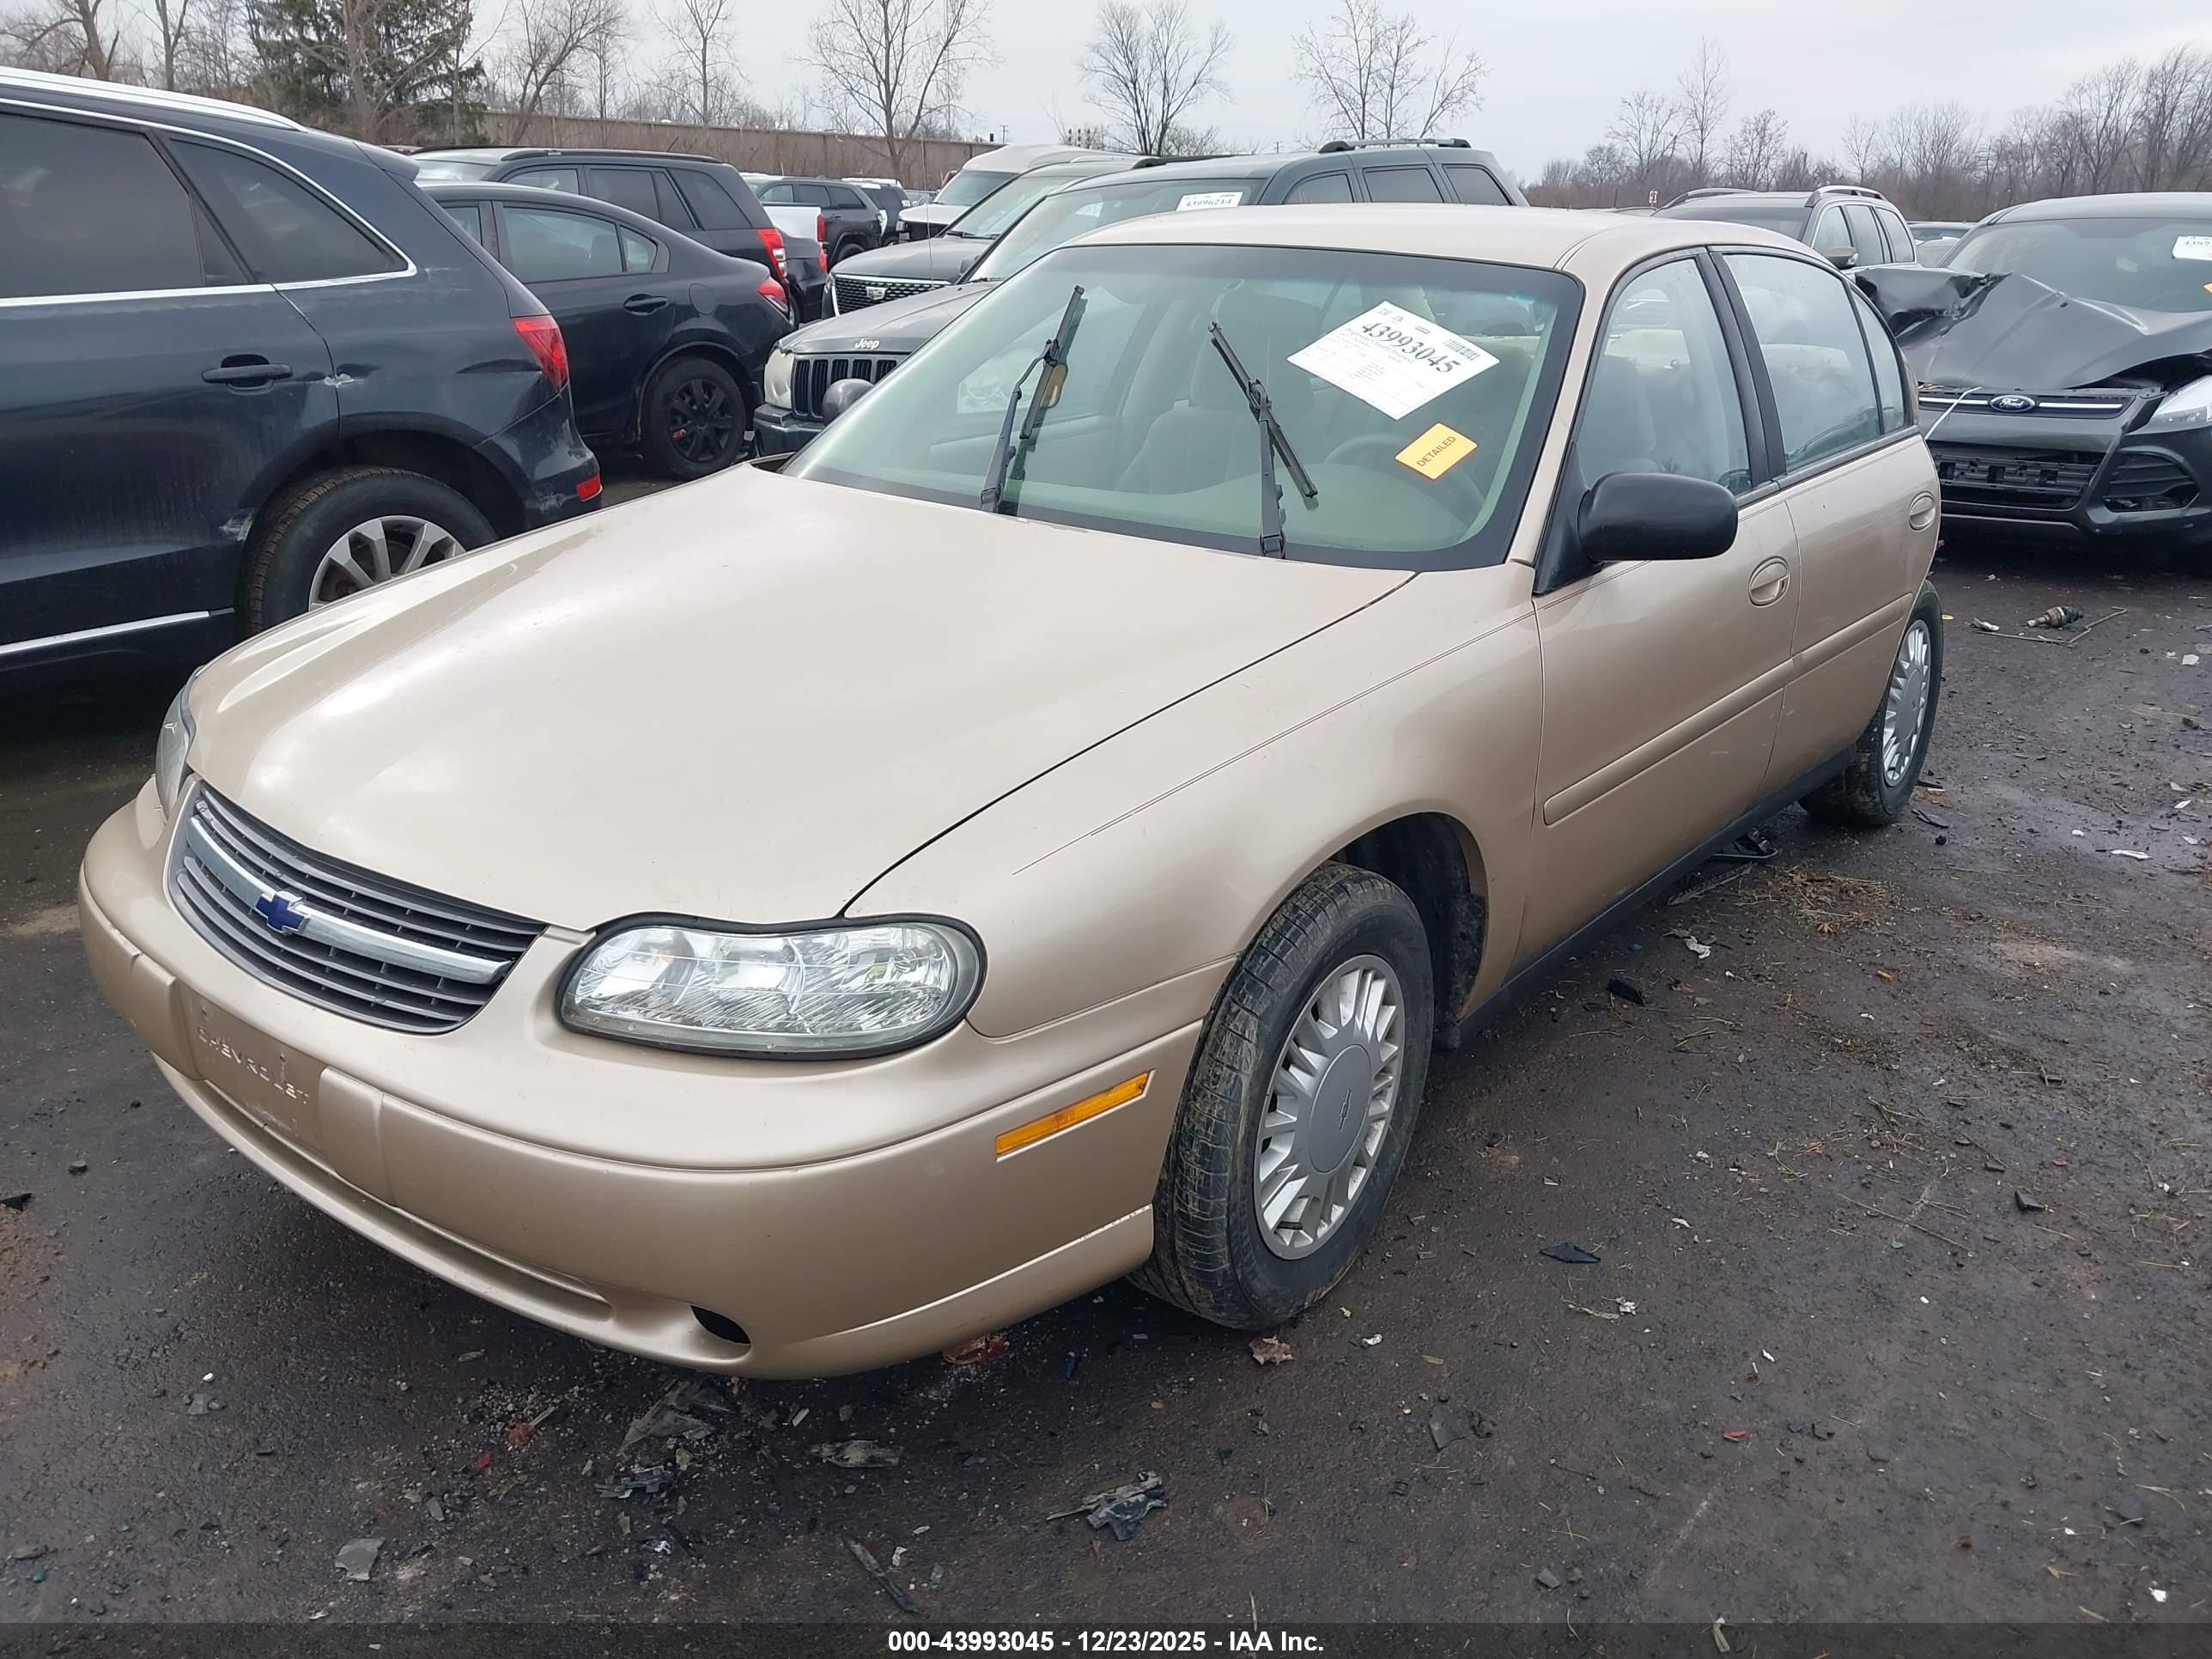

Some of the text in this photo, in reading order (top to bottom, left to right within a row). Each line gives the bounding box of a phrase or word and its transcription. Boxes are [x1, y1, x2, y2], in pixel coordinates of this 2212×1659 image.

[854, 338, 880, 350] Jeep
[1362, 323, 1461, 373] 43993045
[1999, 398, 2025, 409] Ford
[1416, 436, 1456, 466] DETAILED
